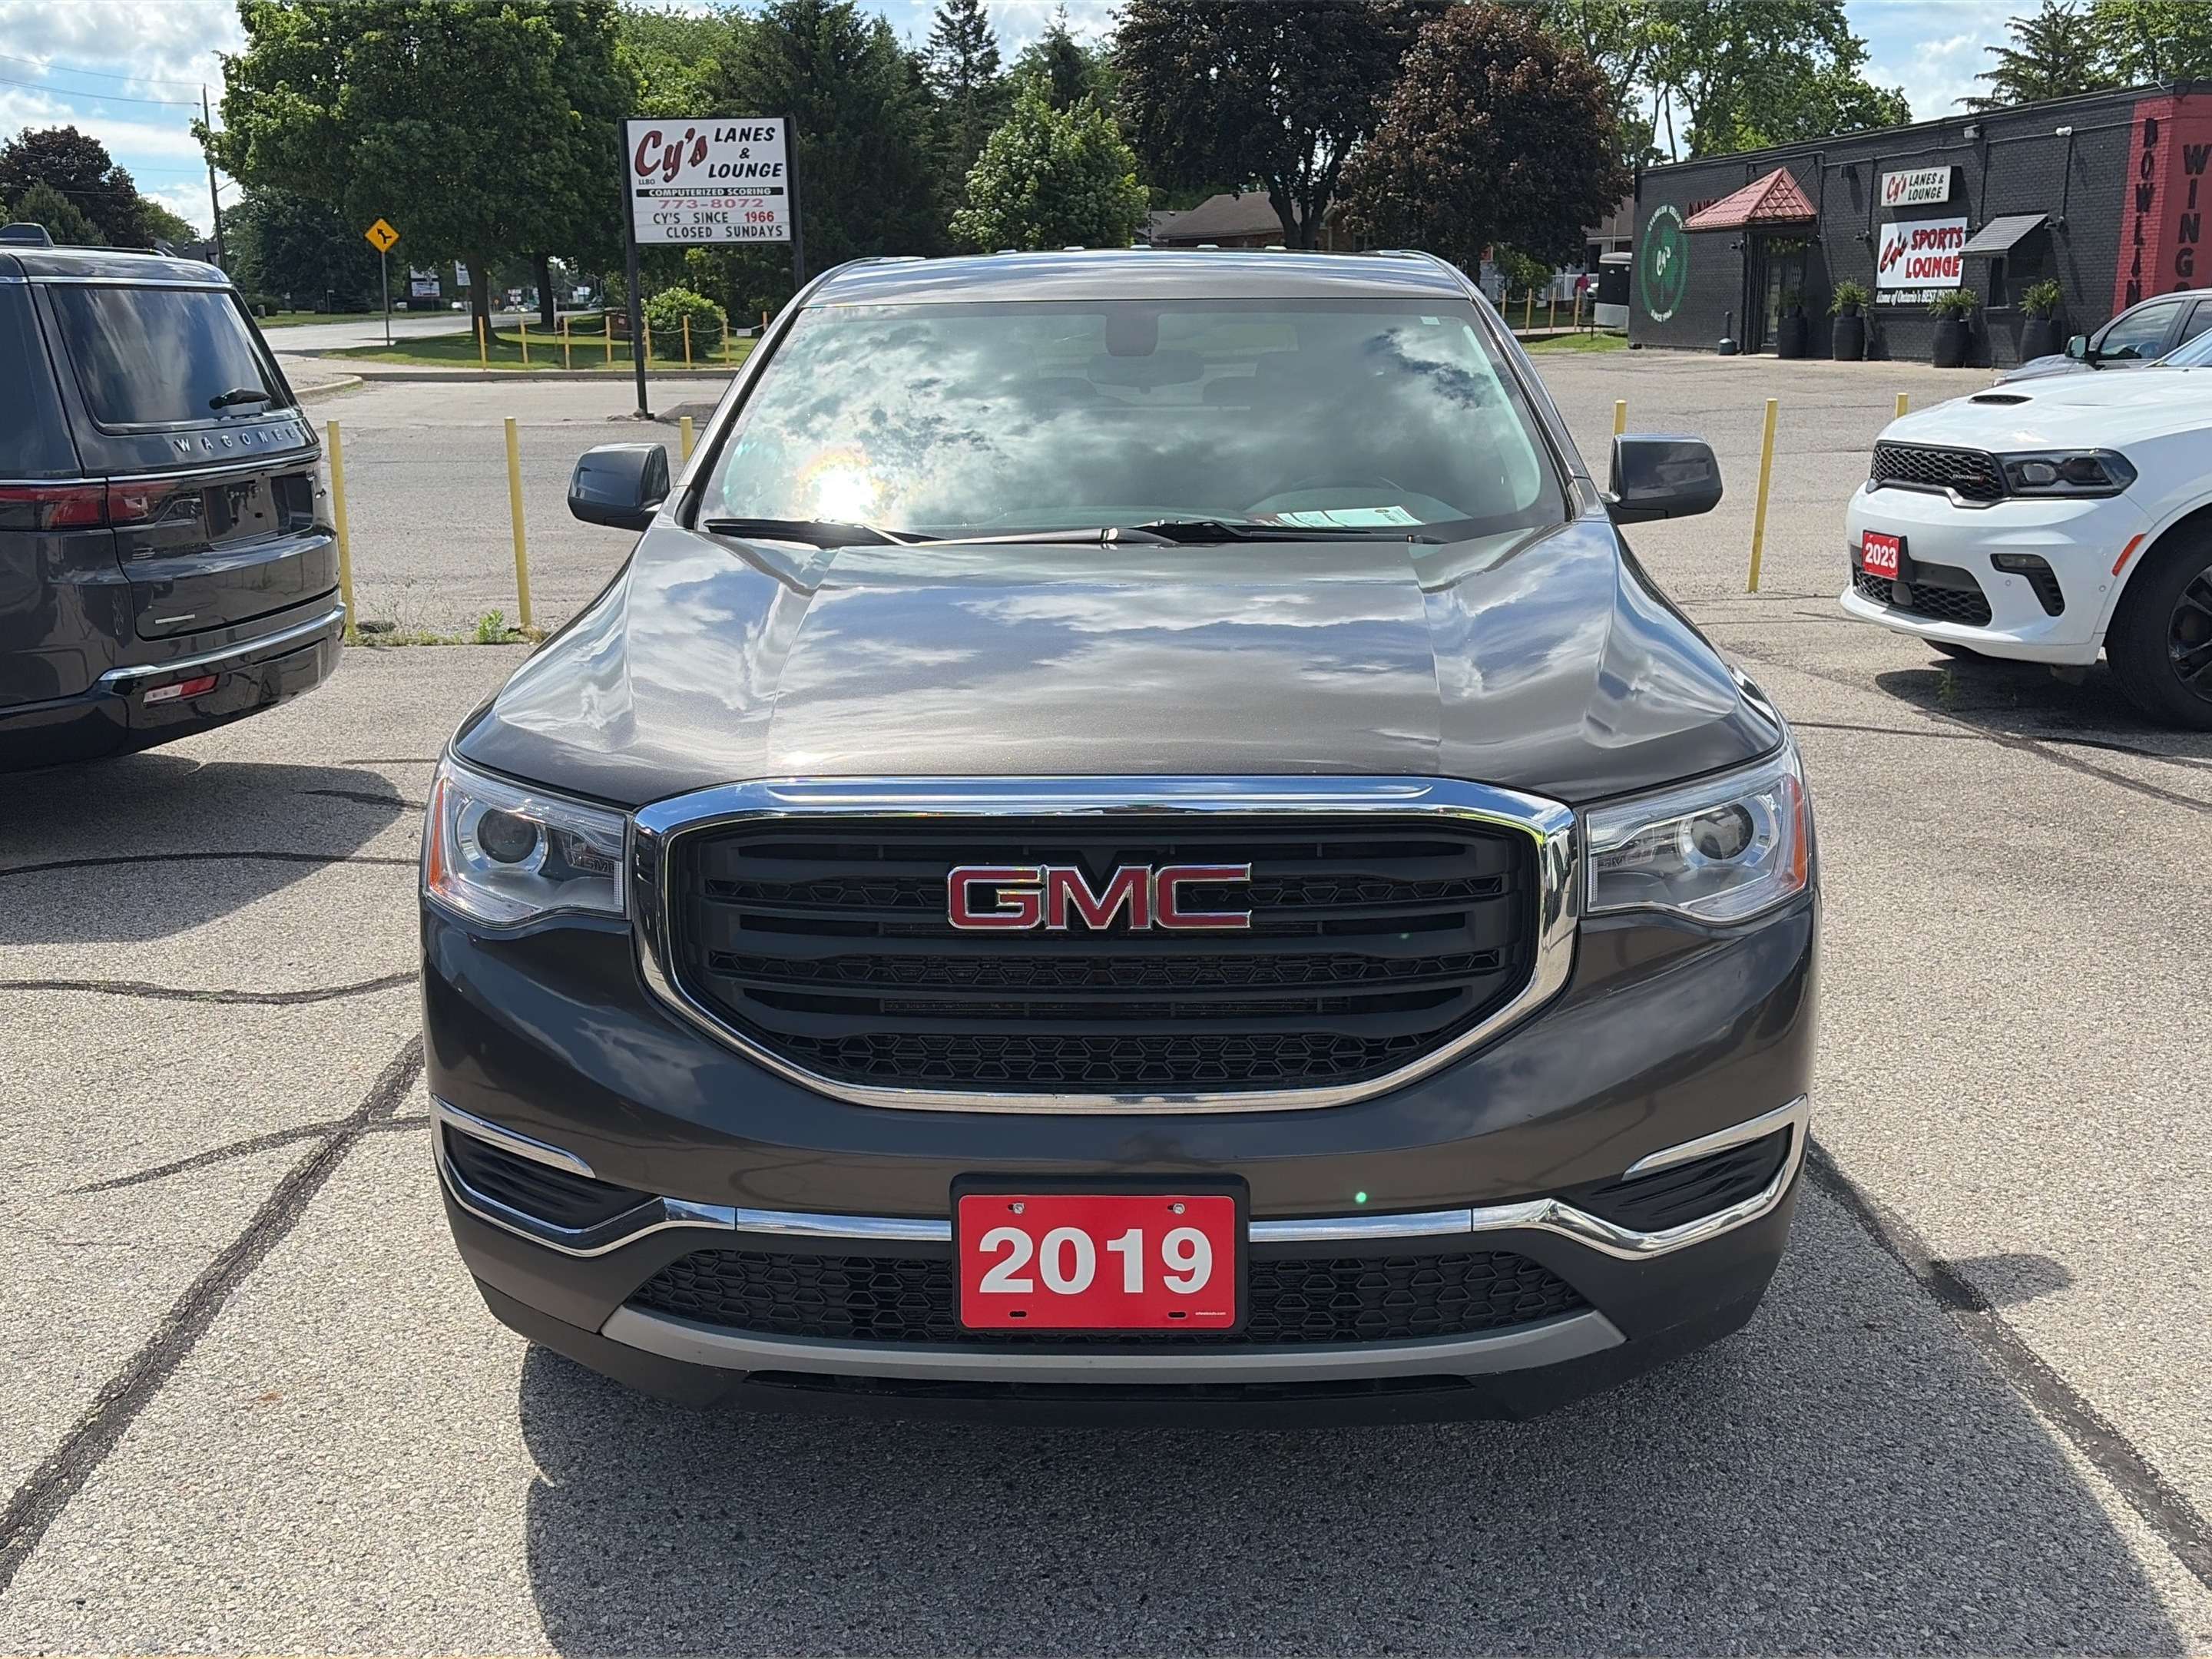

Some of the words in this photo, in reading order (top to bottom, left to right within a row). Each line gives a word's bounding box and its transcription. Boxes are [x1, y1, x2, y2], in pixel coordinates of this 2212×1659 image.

[714, 127, 776, 143] LANES
[634, 127, 708, 183] Cy's
[739, 147, 750, 159] &
[708, 163, 783, 179] LOUNGE
[1909, 172, 1937, 187] LANES
[1938, 174, 1944, 184] &
[649, 188, 724, 197] COMPUTERIZED
[727, 187, 772, 196] SCORING
[1908, 186, 1942, 201] LOUNGE
[659, 198, 764, 209] 773-8072
[653, 212, 681, 224] CY'S
[694, 211, 729, 224] SINCE
[744, 210, 775, 223] 1966
[666, 227, 713, 238] CLOSED
[725, 225, 783, 237] SUNDAYS
[1911, 227, 1964, 252] SPORTS
[1905, 256, 1961, 278] LOUNGE
[1865, 542, 1896, 569] 2023
[947, 863, 1253, 931] GMC
[979, 1226, 1214, 1296] 2019
